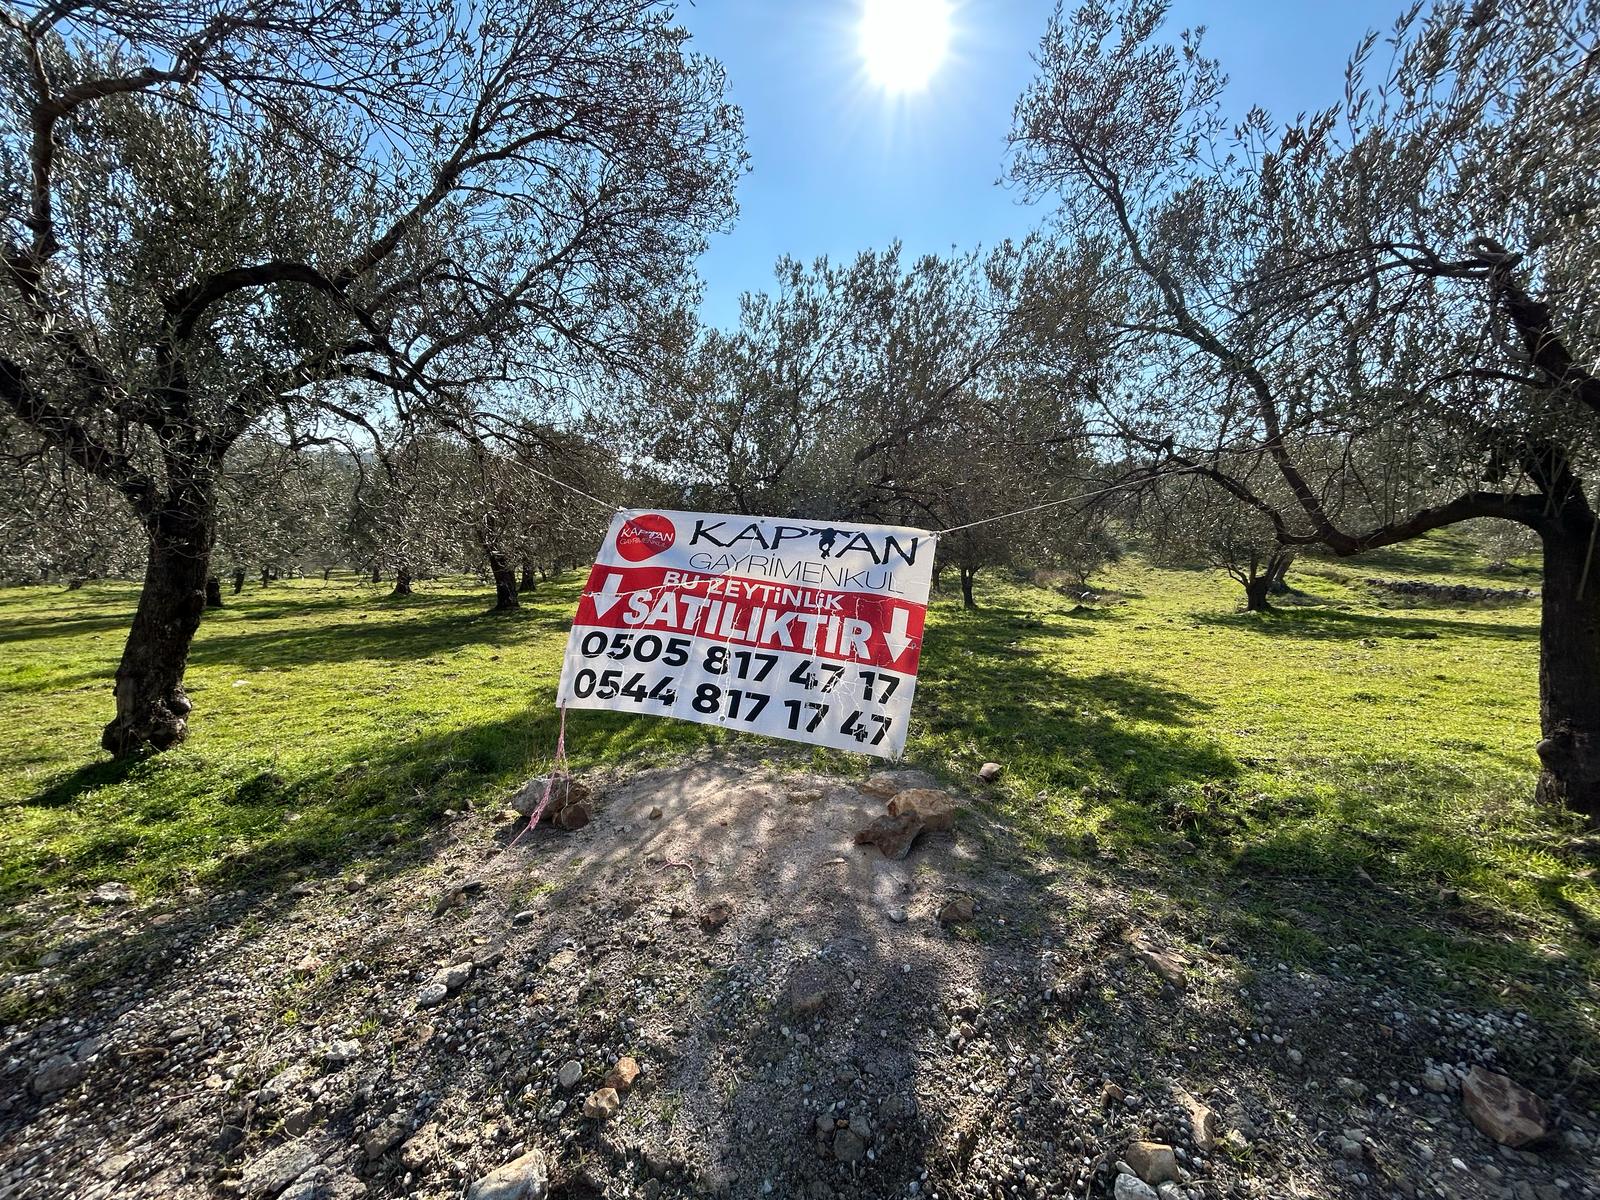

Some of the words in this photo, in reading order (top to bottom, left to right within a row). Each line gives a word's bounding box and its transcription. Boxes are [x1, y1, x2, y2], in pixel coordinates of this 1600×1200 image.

[689, 519, 918, 567] KAPTAN
[662, 571, 698, 590] BU
[689, 552, 904, 594] GAYRİMENKUL
[622, 589, 873, 660] SATILIKTIR
[581, 631, 691, 667] 0505
[702, 646, 779, 683] 817
[788, 659, 845, 693] 47
[859, 671, 900, 704] 17
[573, 668, 679, 707] 0544
[691, 683, 771, 722] 817
[784, 699, 829, 733] 17
[840, 710, 893, 746] 47
